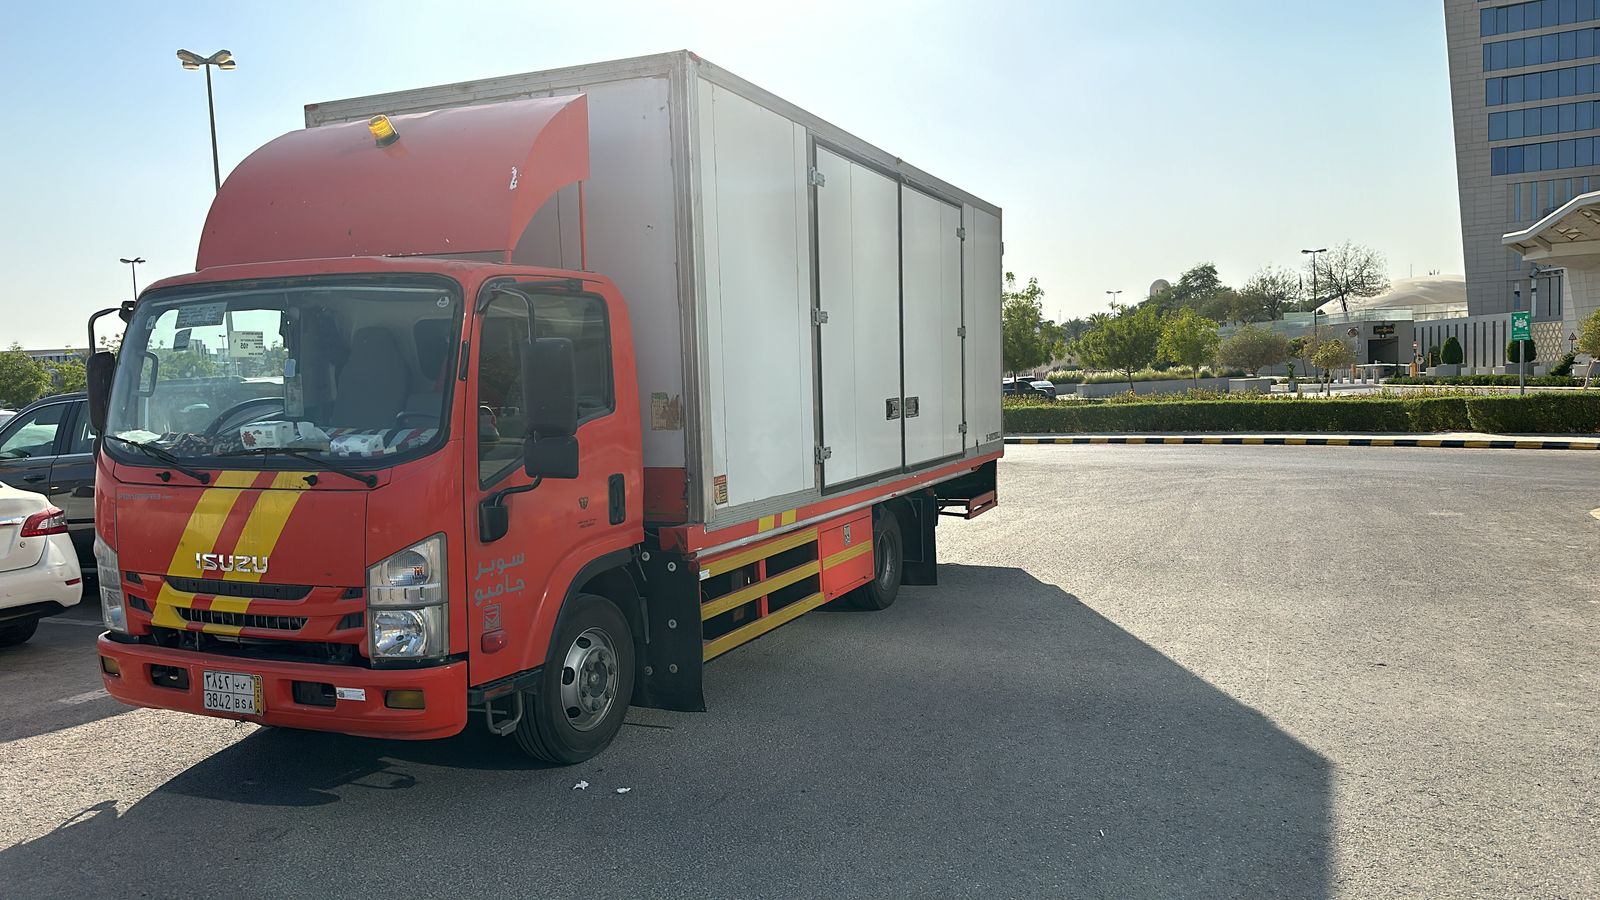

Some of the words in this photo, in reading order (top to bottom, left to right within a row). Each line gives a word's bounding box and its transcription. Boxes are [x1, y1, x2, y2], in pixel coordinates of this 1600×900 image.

[195, 552, 268, 574] ISUZU
[474, 552, 525, 581] سوبر
[474, 574, 525, 607] جامبو
[206, 672, 229, 690] ٣٨٤٢
[206, 692, 231, 709] 3842
